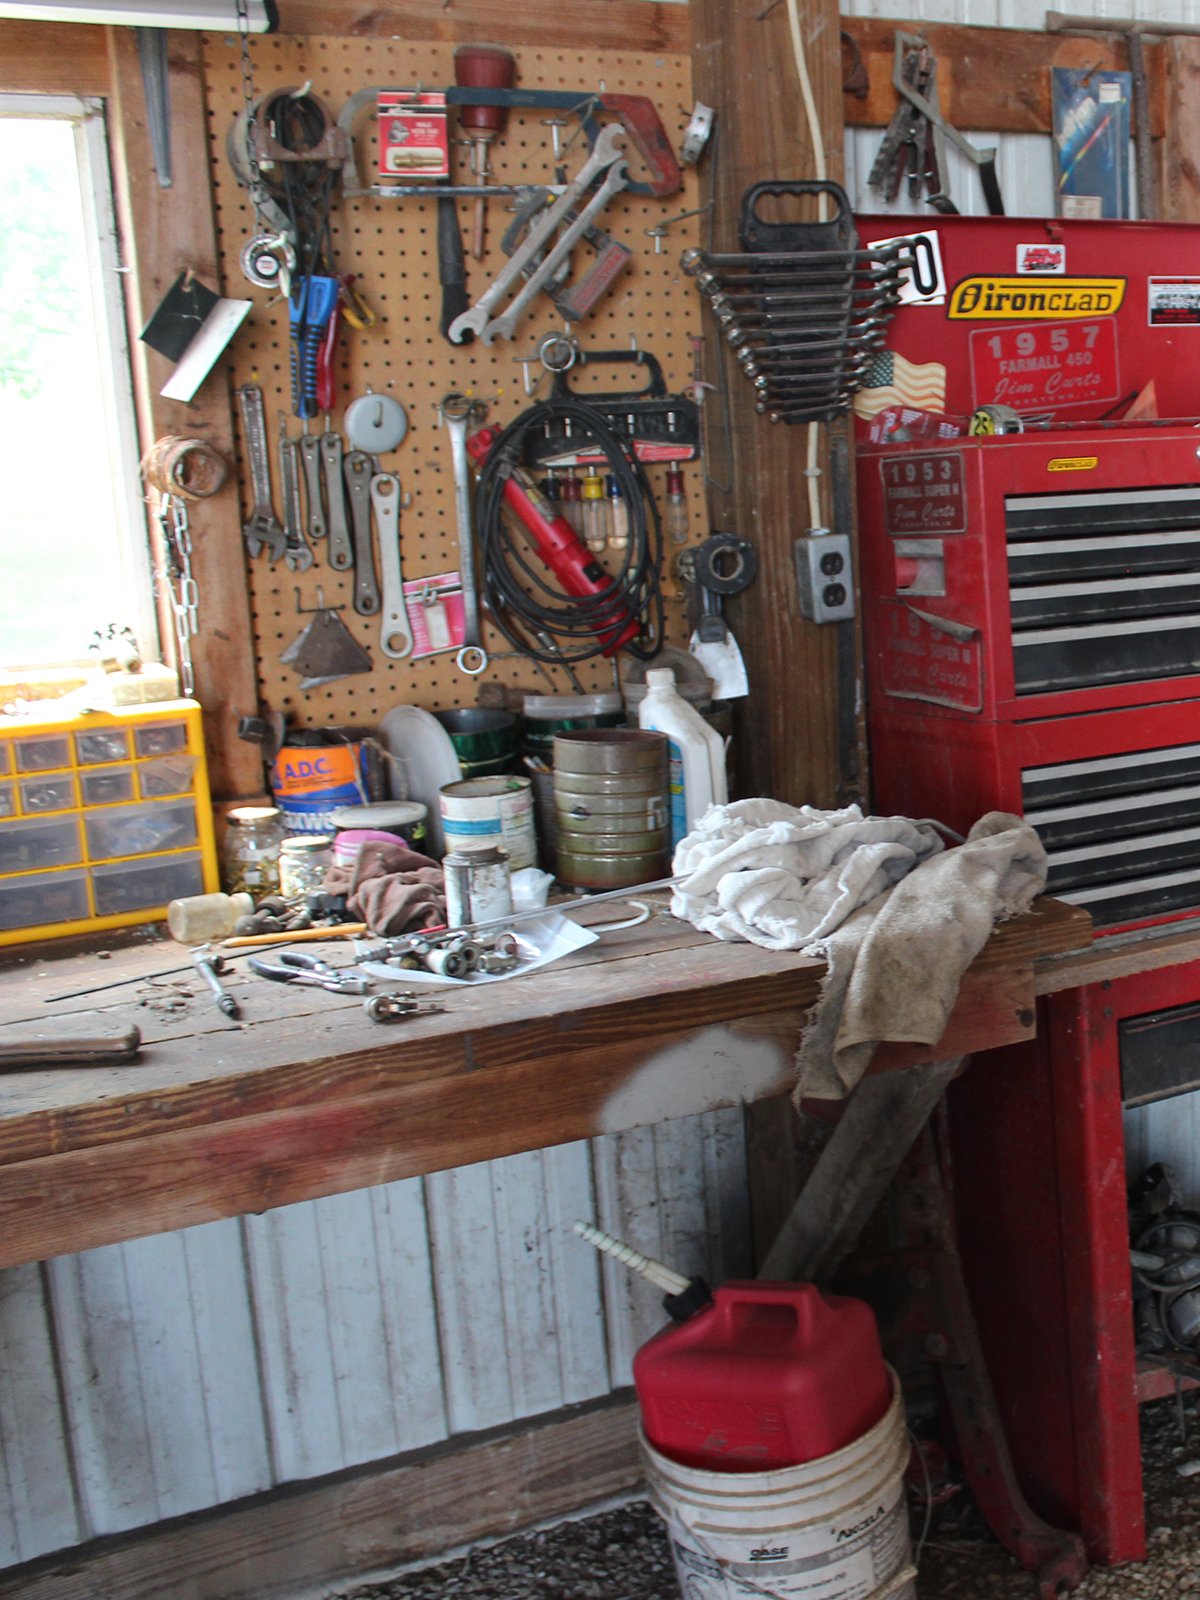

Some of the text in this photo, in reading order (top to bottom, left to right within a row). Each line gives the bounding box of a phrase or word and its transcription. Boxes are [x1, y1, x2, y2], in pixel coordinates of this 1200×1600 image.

[1000, 352, 1093, 375] FARMALL 450
[993, 377, 1035, 404] Jim
[891, 460, 952, 483] 1953
[750, 1546, 790, 1558] CASE
